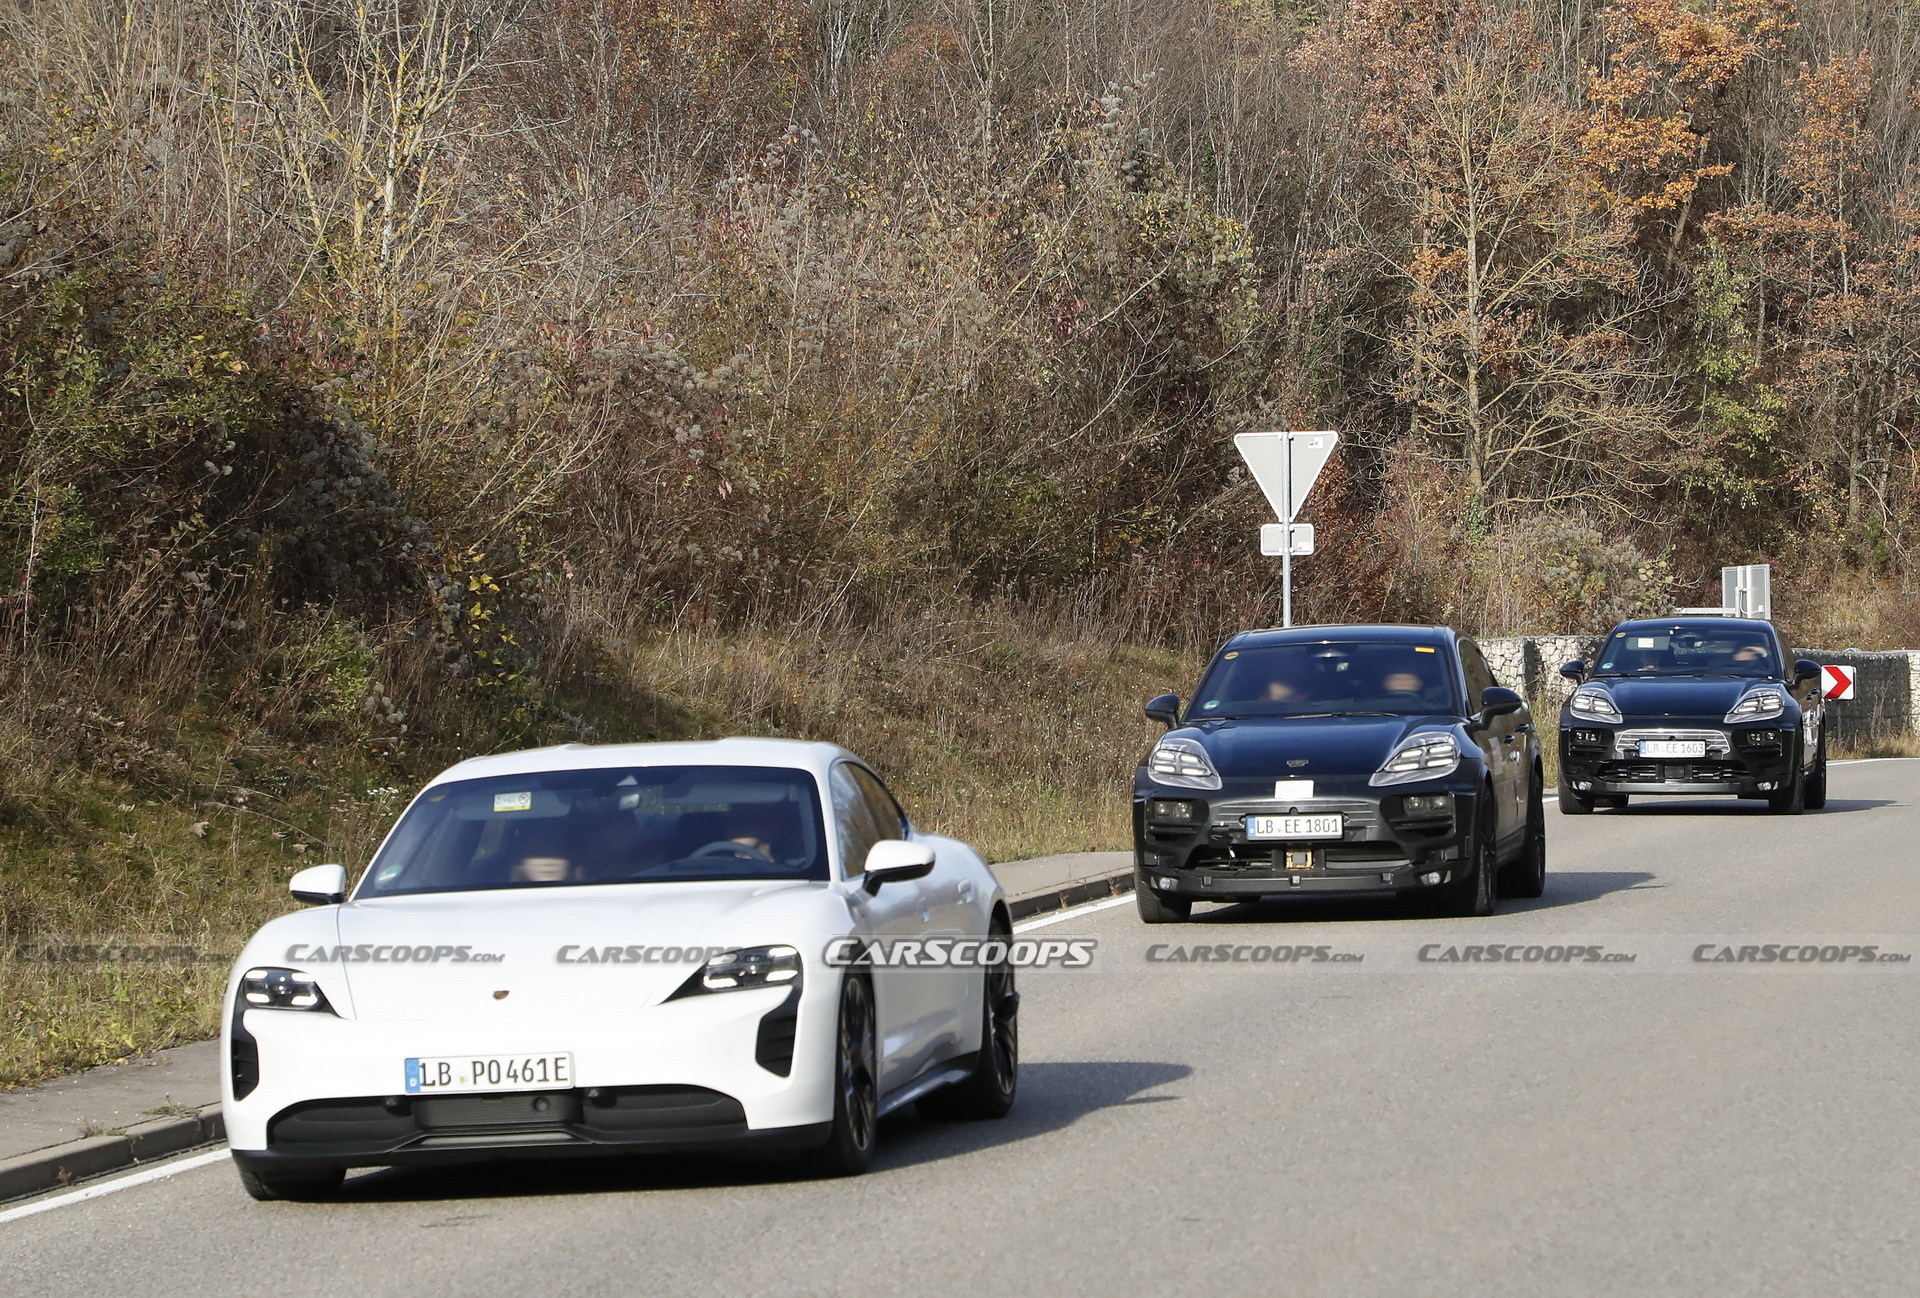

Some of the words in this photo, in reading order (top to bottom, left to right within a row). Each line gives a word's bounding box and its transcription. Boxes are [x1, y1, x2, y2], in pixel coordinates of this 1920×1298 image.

[1256, 819, 1274, 834] LB
[1284, 819, 1302, 834] EE
[1305, 818, 1339, 833] 1801
[421, 1061, 452, 1087] LB
